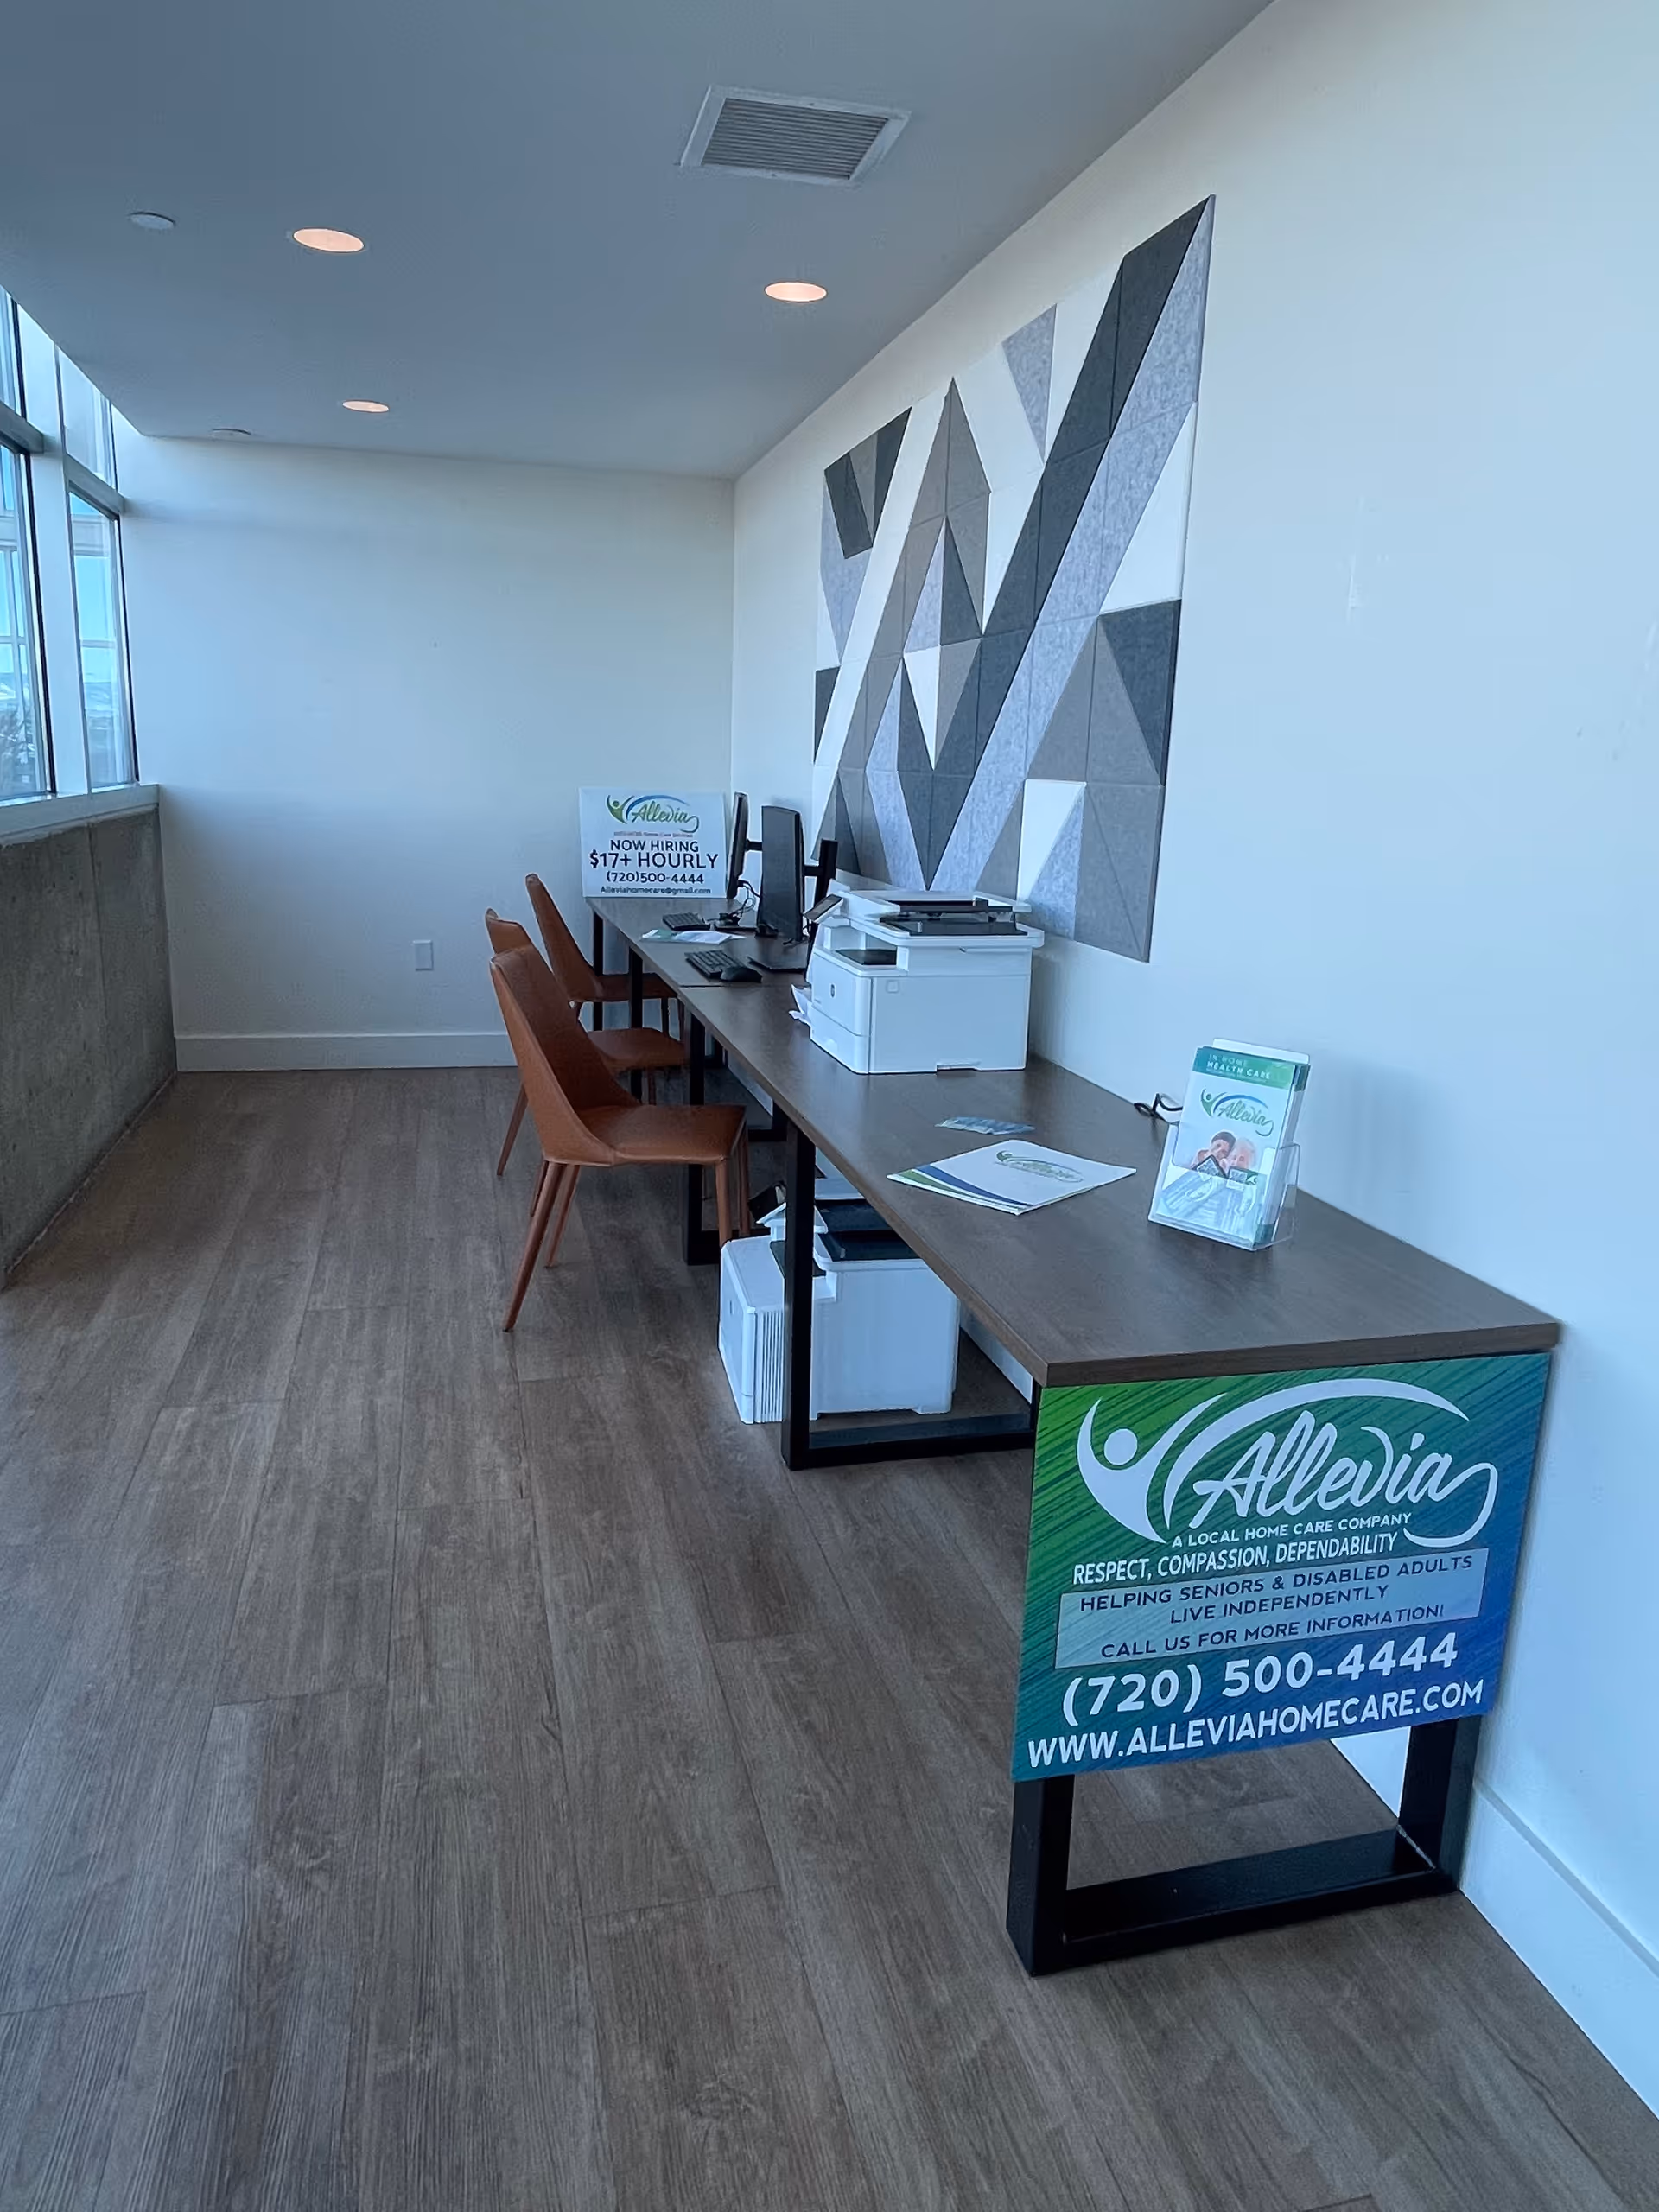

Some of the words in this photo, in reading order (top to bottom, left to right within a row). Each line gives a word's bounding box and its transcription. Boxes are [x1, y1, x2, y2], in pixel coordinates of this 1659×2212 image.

[632, 801, 699, 833] Allevia
[589, 849, 632, 868] $17+
[638, 852, 718, 869] HOURLY
[610, 839, 646, 851] NOW
[651, 840, 699, 853] HIRING
[607, 871, 704, 884] (720)500-4444
[1206, 1061, 1243, 1076] HEALTH
[1246, 1068, 1271, 1080] CARE
[1217, 1099, 1274, 1137] Allevia
[1189, 1410, 1498, 1548] Allevia
[1172, 1539, 1183, 1548] A
[1188, 1532, 1240, 1547] LOCAL
[1244, 1524, 1289, 1541] HOME
[1294, 1520, 1333, 1535] CARE
[1338, 1512, 1412, 1530] COMPANY
[1073, 1558, 1152, 1585] RESPECT,
[1157, 1545, 1270, 1577] COMPASSION,
[1275, 1532, 1398, 1563] DEPENDABILITY
[1081, 1589, 1172, 1611] HELPING
[1179, 1579, 1264, 1601] SENIORS
[1272, 1576, 1284, 1590] &
[1294, 1564, 1389, 1587] DISABLED
[1397, 1555, 1472, 1576] ADULTS
[1171, 1605, 1216, 1624] LIVE
[1224, 1585, 1389, 1617] INDEPENDENTLY
[1101, 1641, 1156, 1658] CALL
[1166, 1636, 1190, 1650] US
[1198, 1630, 1237, 1647] FOR
[1244, 1621, 1300, 1641] MORE
[1306, 1604, 1444, 1633] INFORMATION!
[1062, 1664, 1202, 1726] (720)
[1222, 1632, 1458, 1697] 500-4444
[1027, 1679, 1484, 1768] WWW.ALLEVIAHOMECARE.COM
